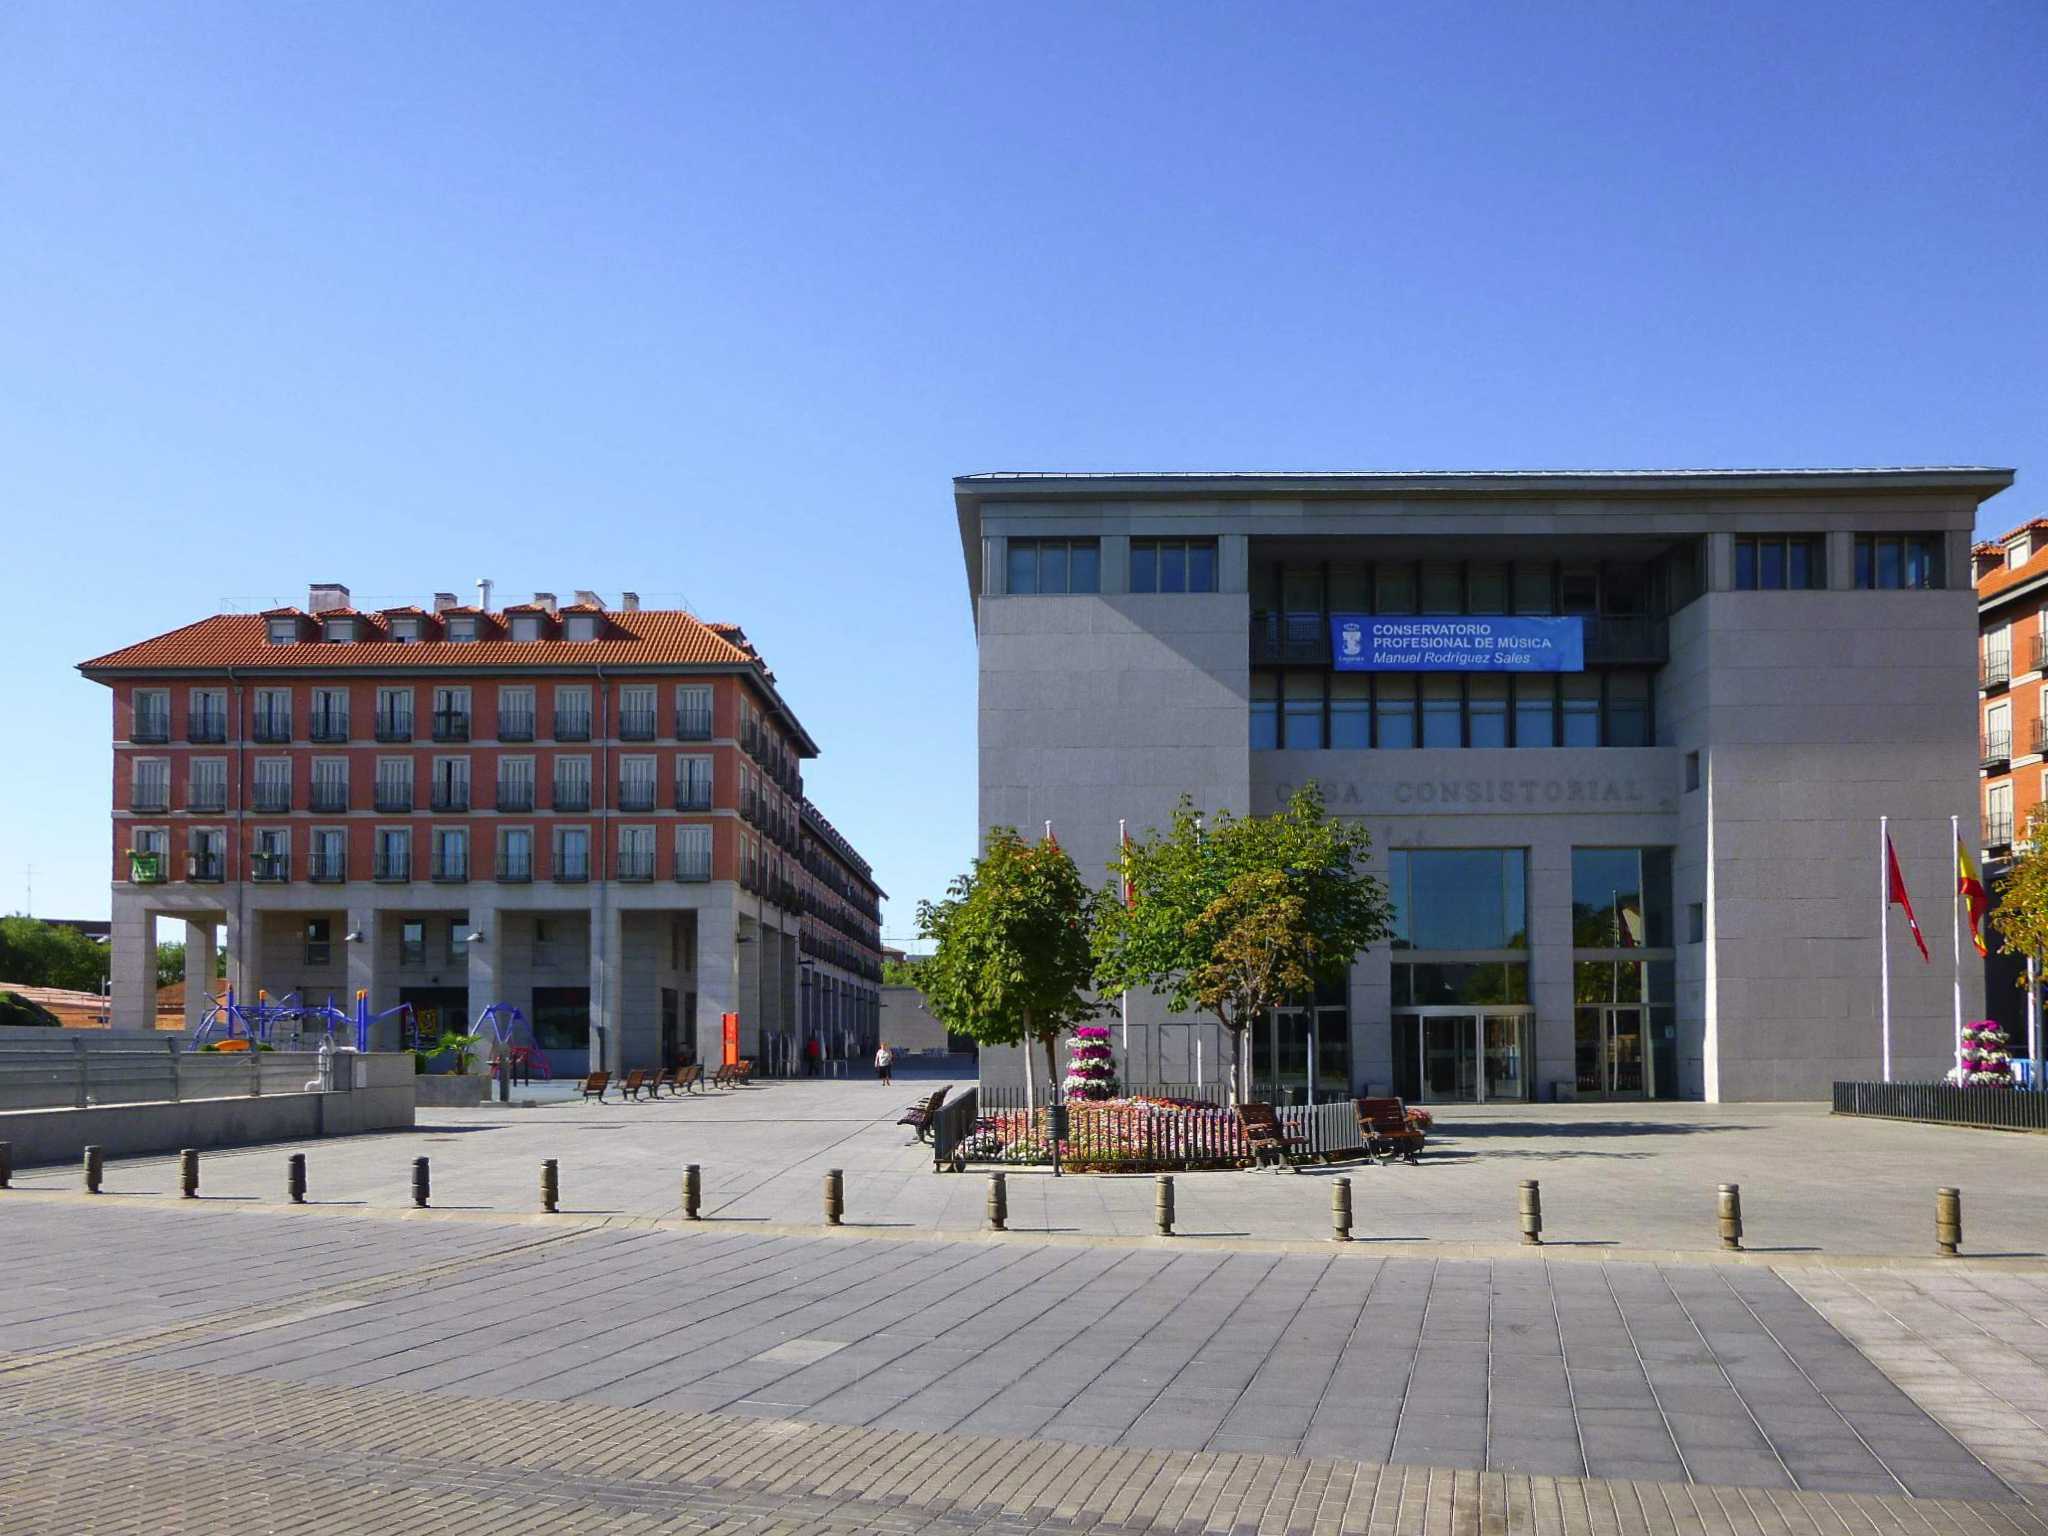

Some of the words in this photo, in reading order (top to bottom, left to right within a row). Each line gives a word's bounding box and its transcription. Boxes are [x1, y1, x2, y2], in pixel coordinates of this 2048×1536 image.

[1373, 624, 1491, 635] CONSERVATORIO
[1373, 637, 1471, 648] PROFESIONAL
[1475, 637, 1493, 648] DE
[1498, 635, 1552, 648] MÚSICA
[1373, 652, 1421, 664] Manuel
[1494, 651, 1531, 664] Sales
[1275, 781, 1363, 804] CSA
[1394, 779, 1644, 804] CONSISTORIAL
